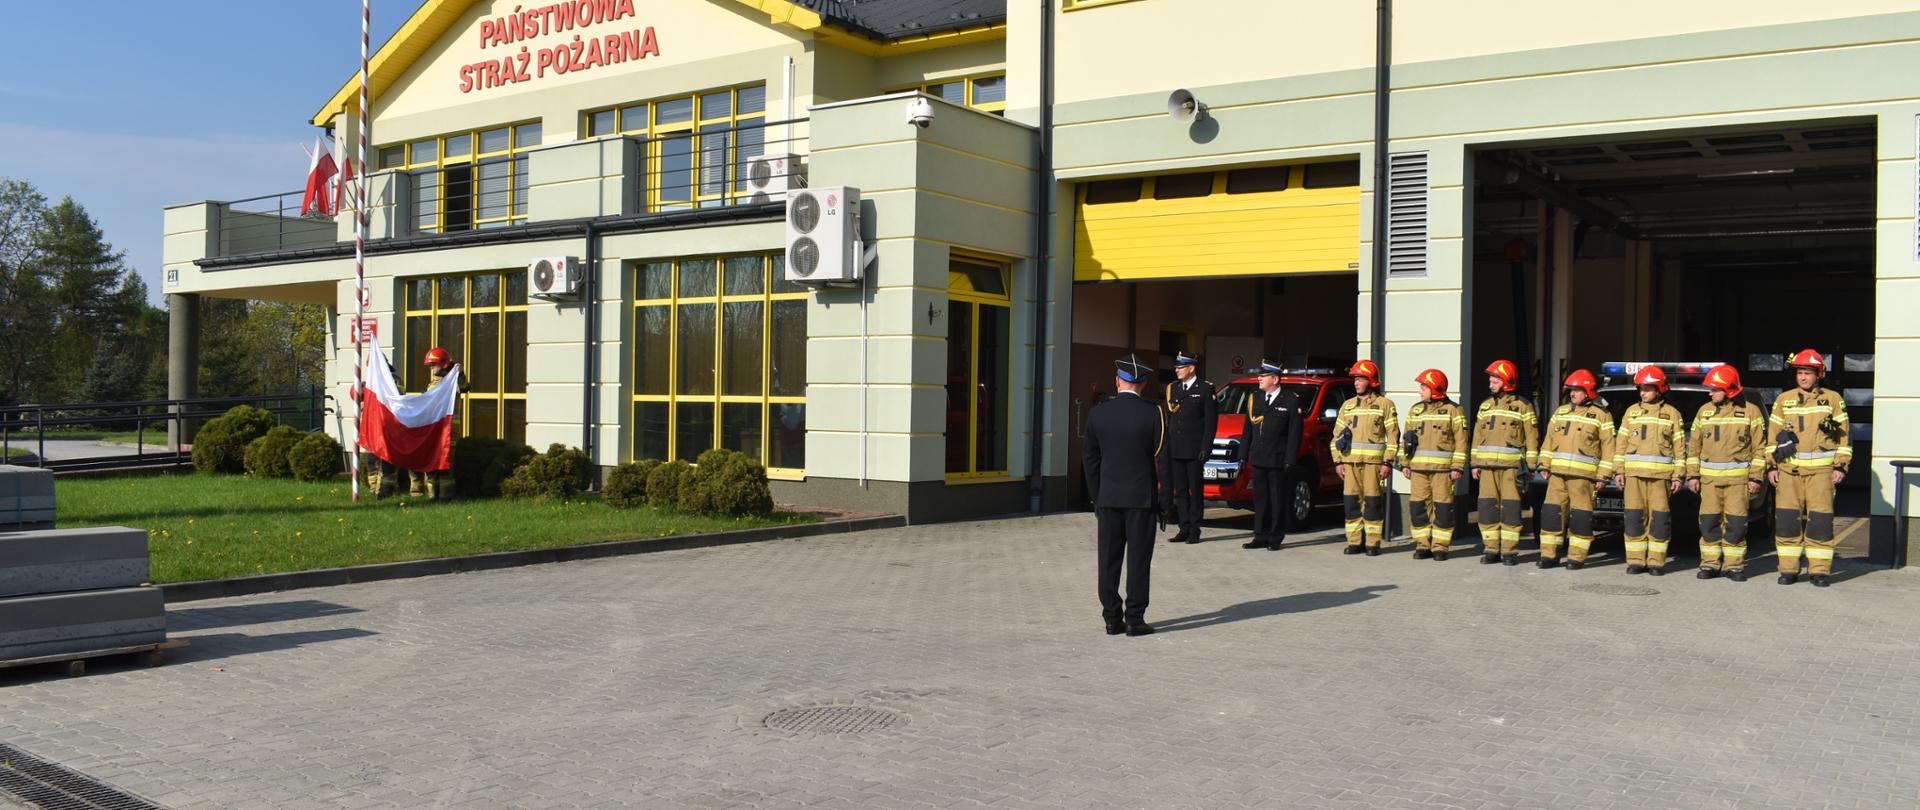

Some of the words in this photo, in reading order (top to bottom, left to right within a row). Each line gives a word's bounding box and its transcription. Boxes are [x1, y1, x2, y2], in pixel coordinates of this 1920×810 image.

[480, 0, 635, 49] PAŃSTWOWA
[459, 46, 531, 93] STRAŻ
[537, 26, 660, 79] POŻARNA
